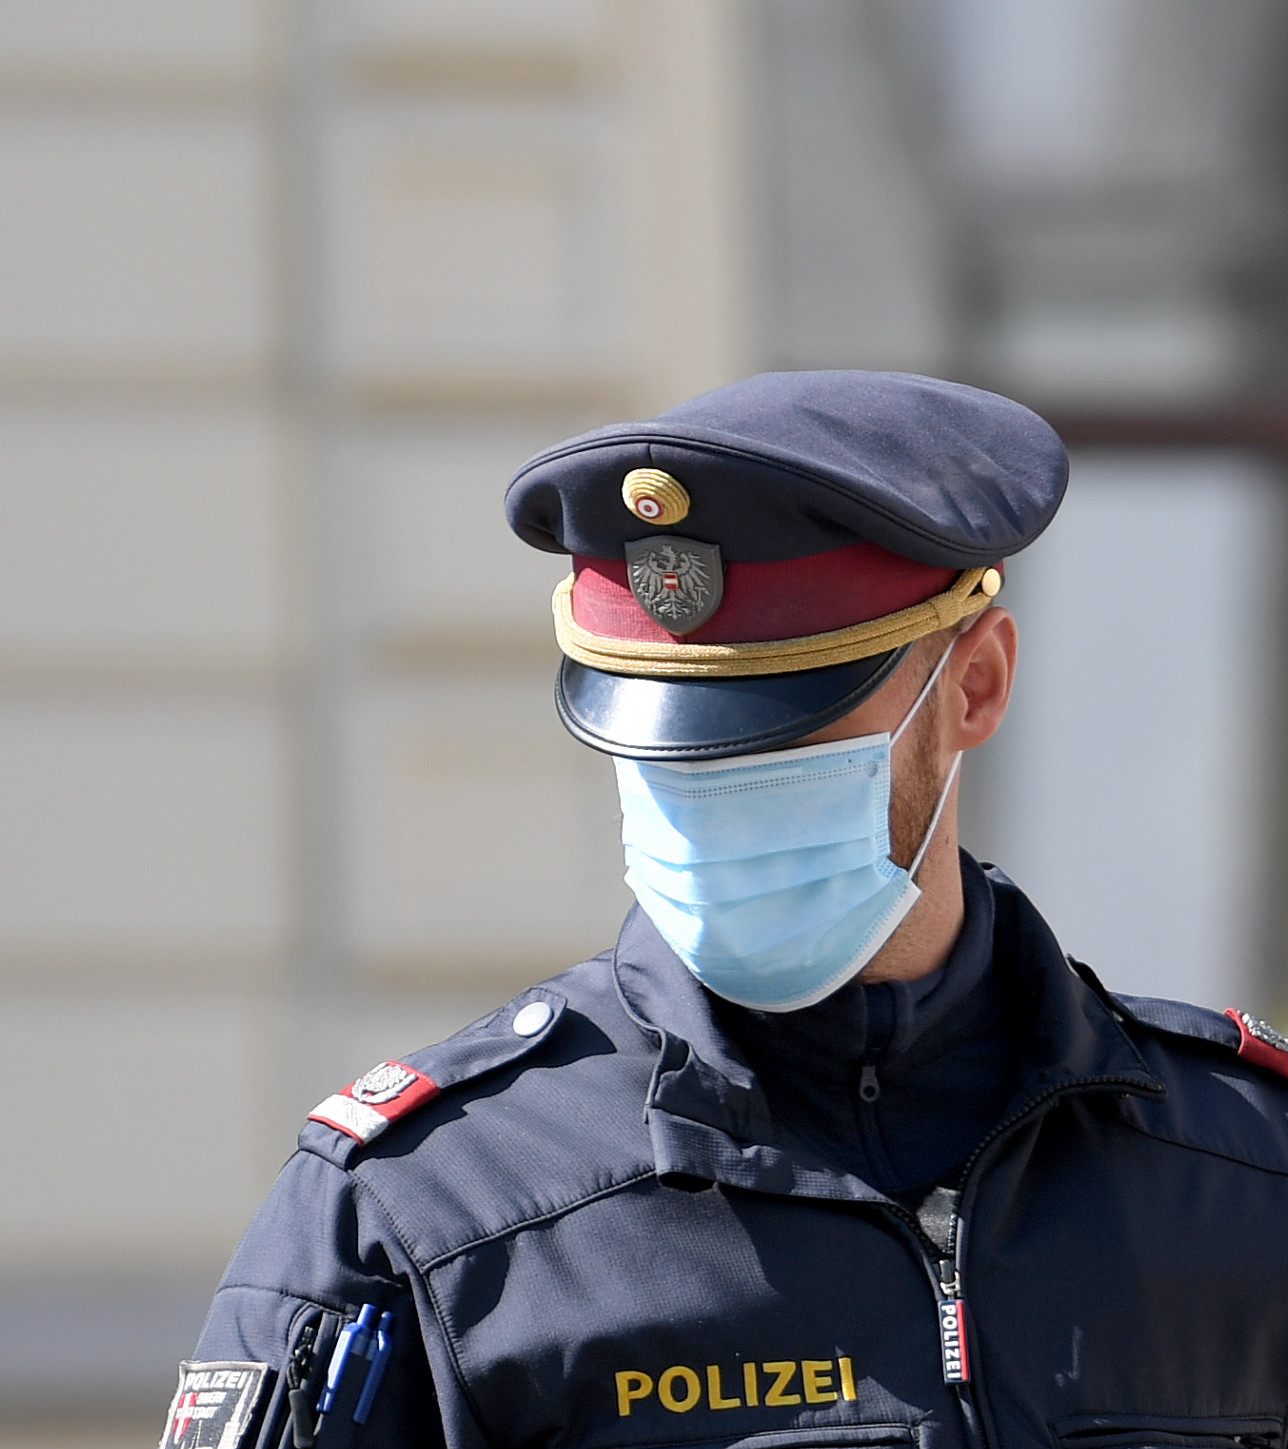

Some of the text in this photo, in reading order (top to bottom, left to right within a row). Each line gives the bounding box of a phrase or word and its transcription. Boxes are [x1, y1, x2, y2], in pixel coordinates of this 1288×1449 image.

[941, 1303, 963, 1380] POLIZEI
[184, 1370, 248, 1392] POLIZEI
[615, 1356, 858, 1418] POLIZEI
